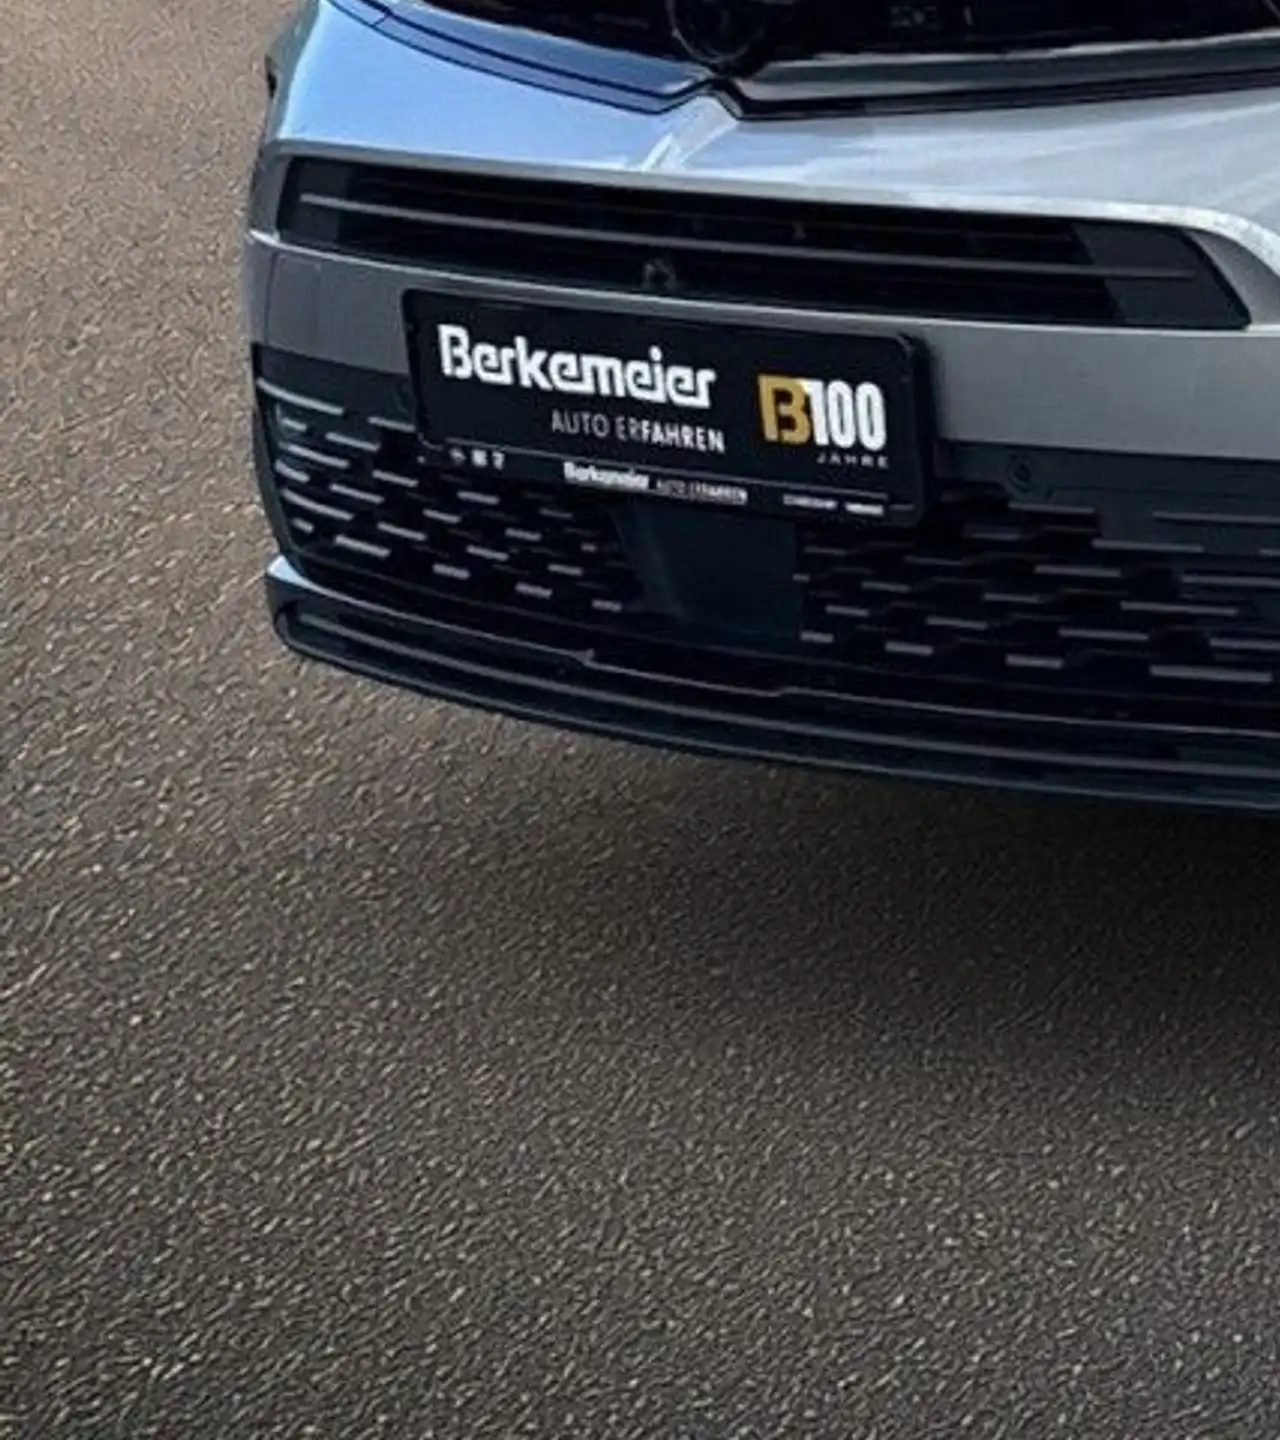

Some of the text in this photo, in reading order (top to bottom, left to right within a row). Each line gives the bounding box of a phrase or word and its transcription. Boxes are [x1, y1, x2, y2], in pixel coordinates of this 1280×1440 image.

[437, 323, 717, 409] Berkemeier
[551, 409, 726, 454] AUTO ERFAHREN
